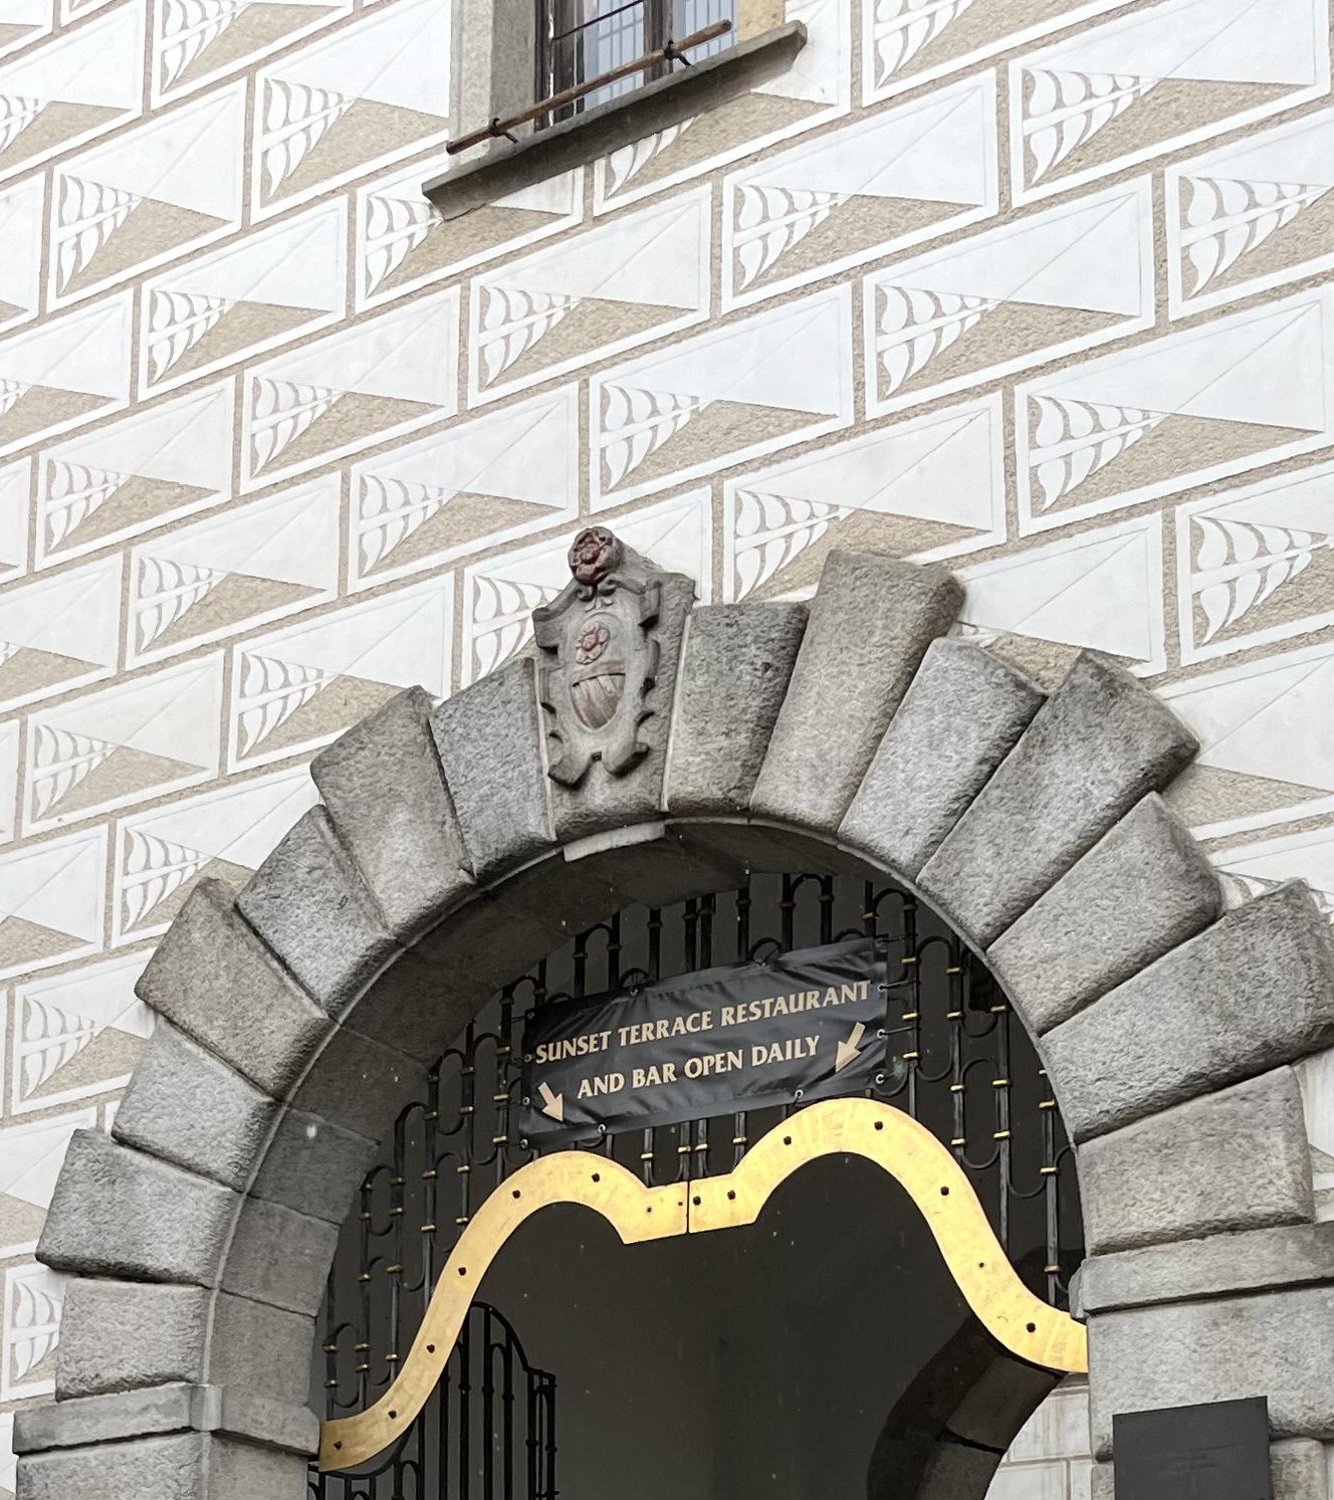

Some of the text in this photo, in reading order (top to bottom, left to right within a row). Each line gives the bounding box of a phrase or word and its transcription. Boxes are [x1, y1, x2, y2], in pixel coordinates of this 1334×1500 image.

[536, 980, 871, 1064] SUNSET TERRACE RESTAURANT
[577, 1034, 821, 1099] AND BAR OPEN DAILY
